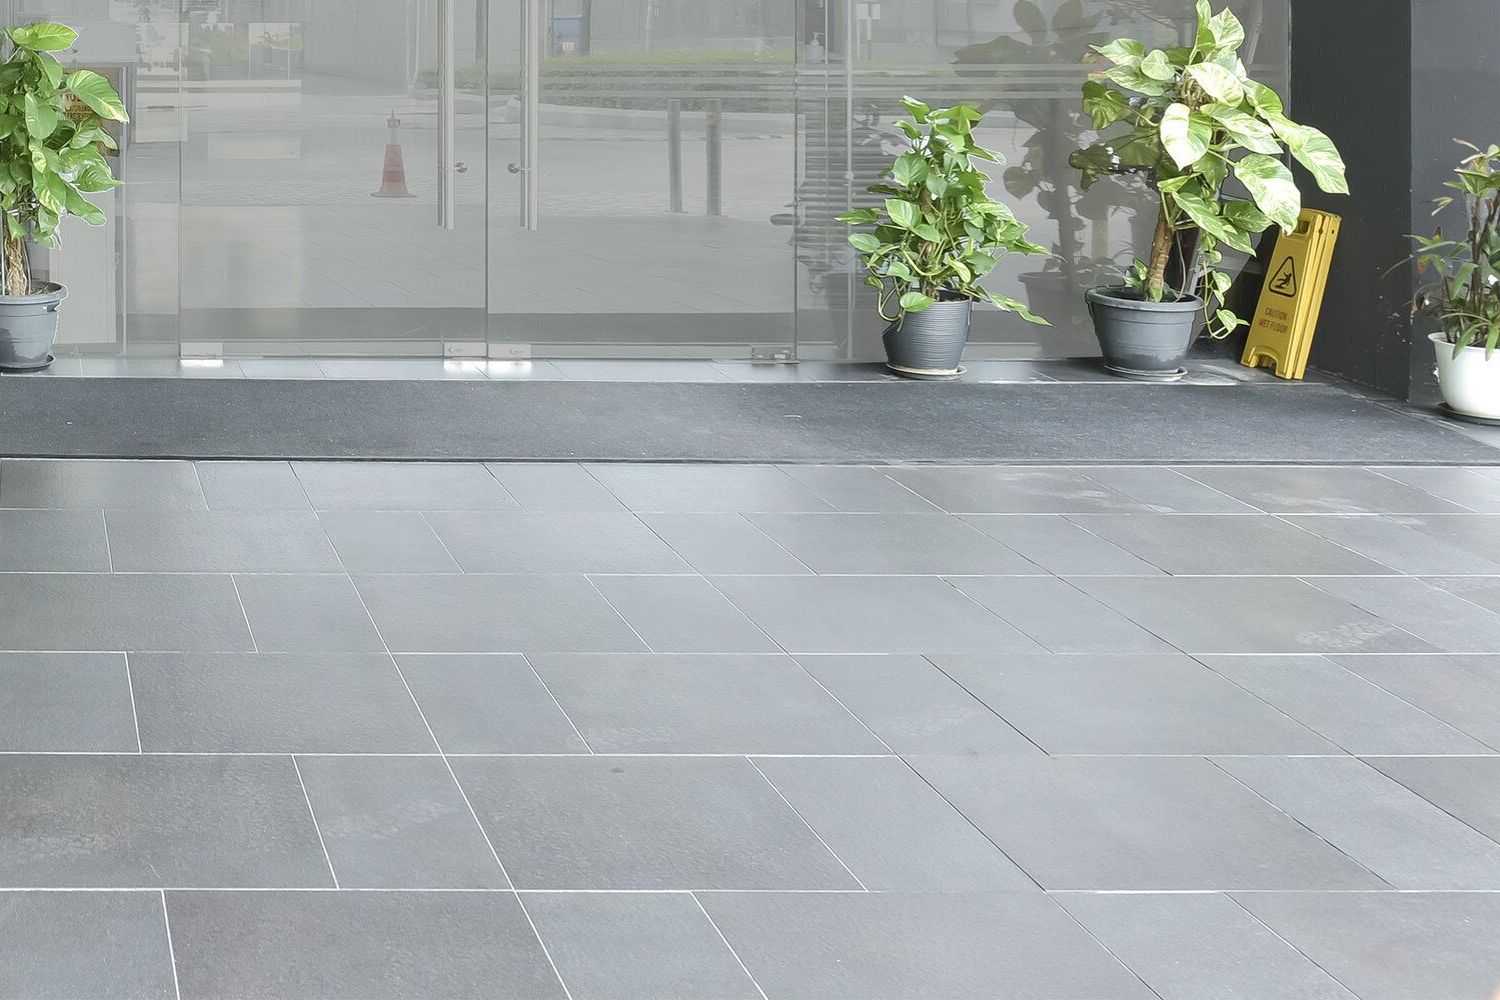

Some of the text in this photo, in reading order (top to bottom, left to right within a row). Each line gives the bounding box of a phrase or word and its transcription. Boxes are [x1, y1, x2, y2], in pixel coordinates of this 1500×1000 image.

[1265, 307, 1288, 320] CAUTION
[1259, 318, 1288, 334] WET FLOOR
